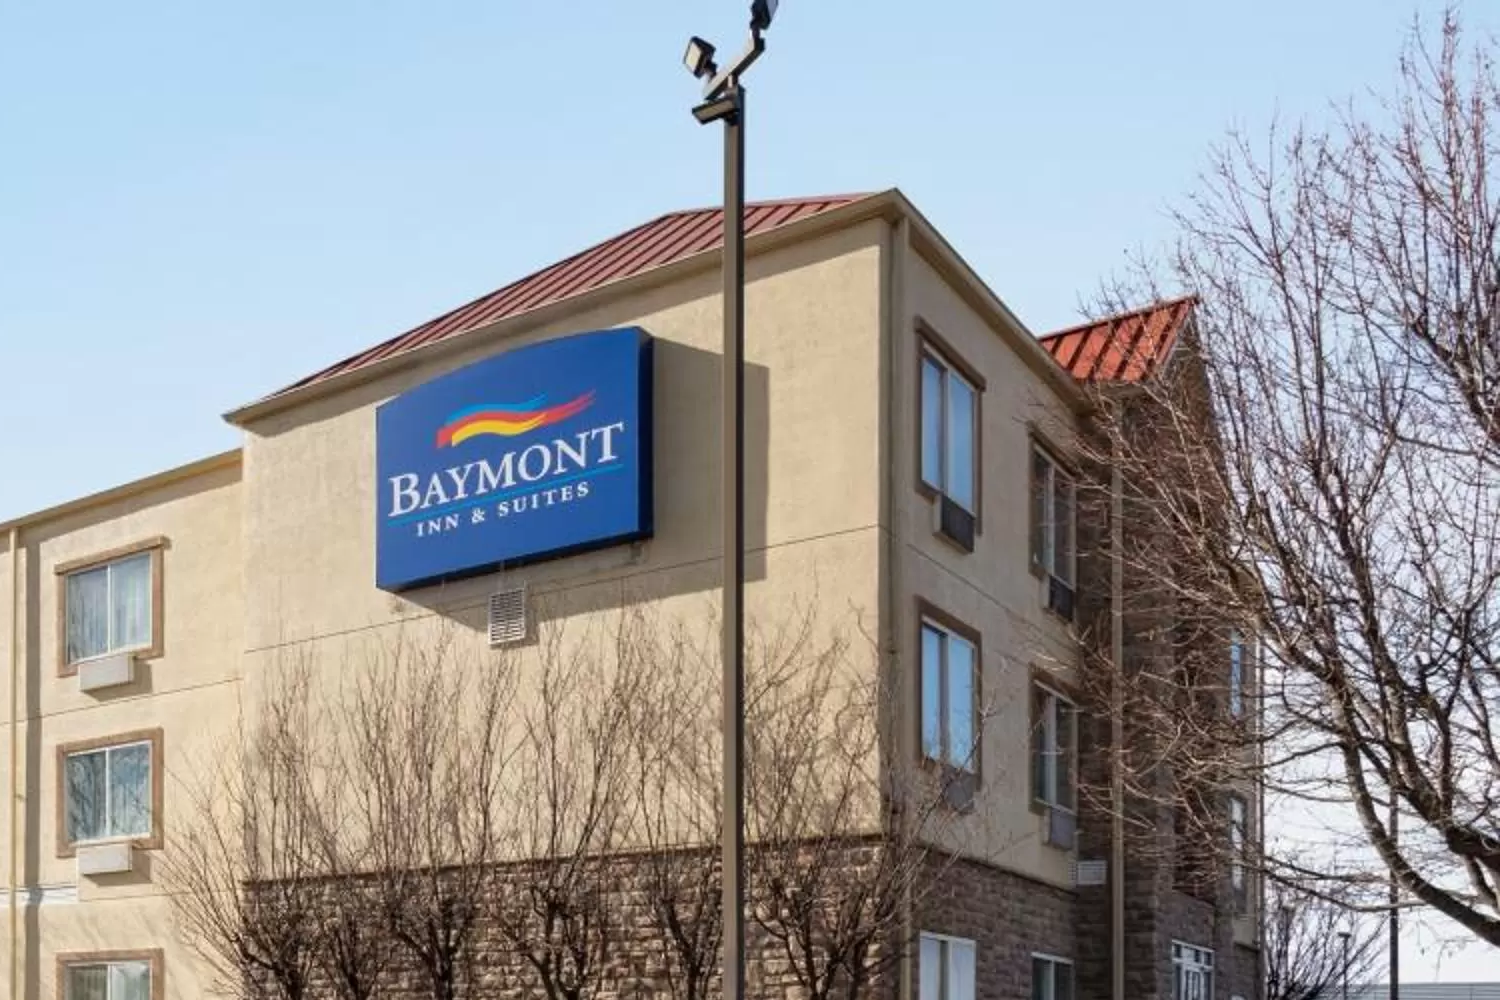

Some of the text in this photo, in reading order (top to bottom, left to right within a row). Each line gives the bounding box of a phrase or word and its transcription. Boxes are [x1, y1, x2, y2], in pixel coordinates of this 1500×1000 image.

[388, 421, 624, 517] BAYMONT
[416, 481, 590, 537] INN & SUITES
